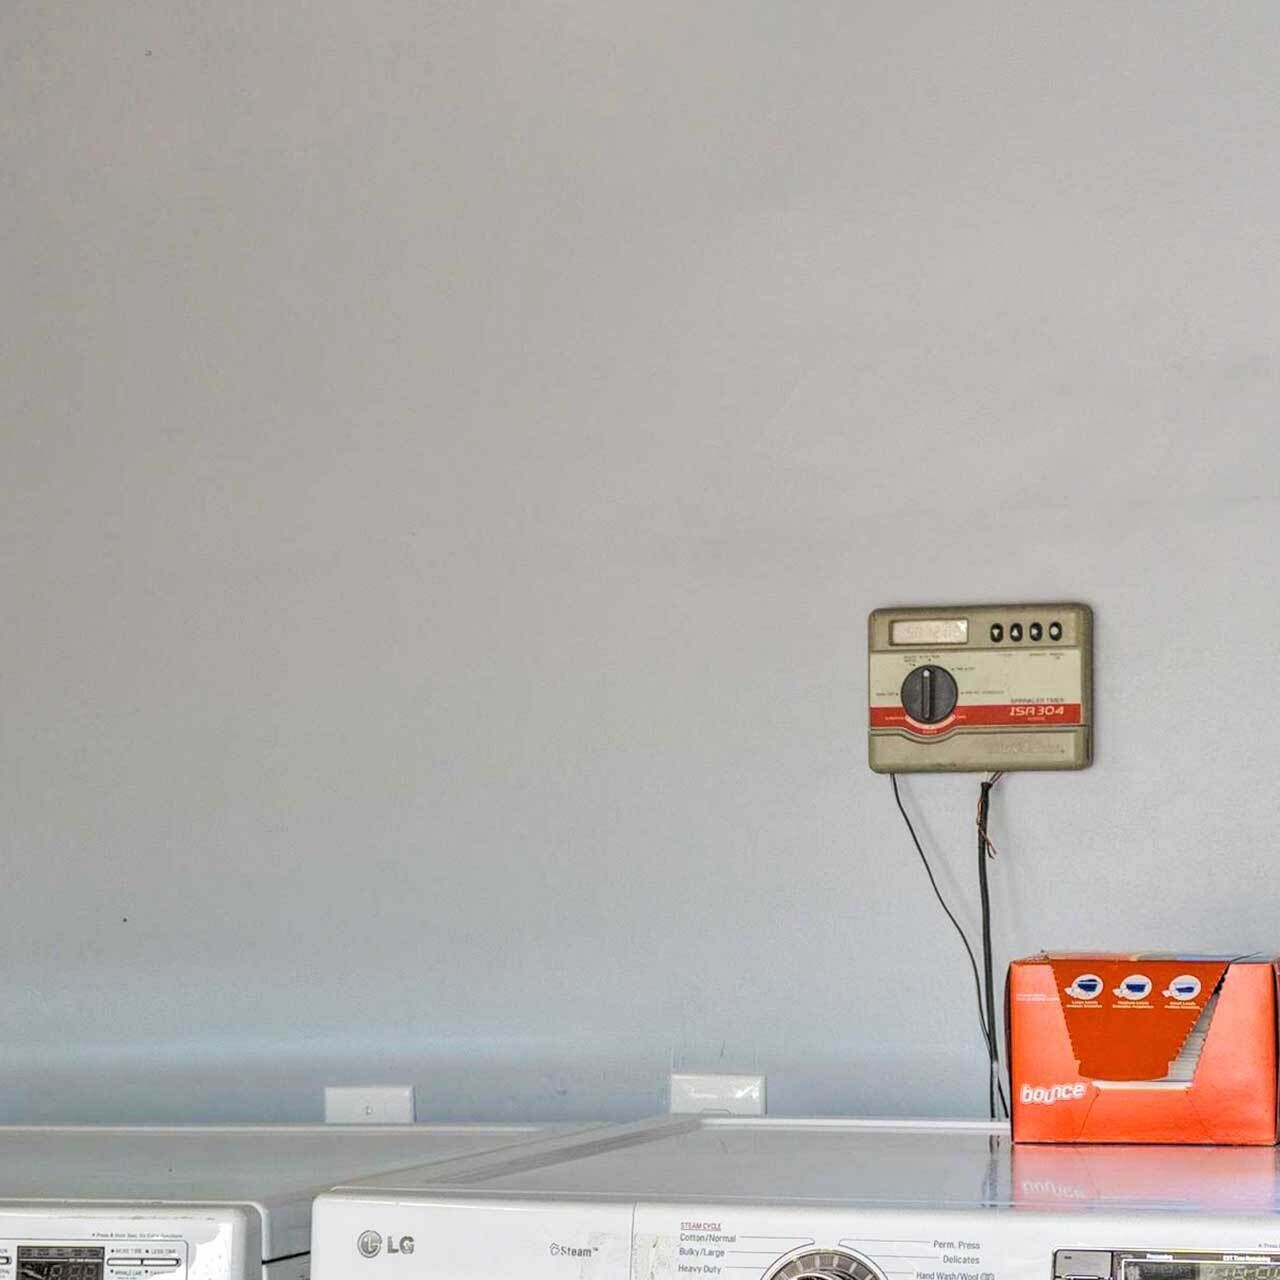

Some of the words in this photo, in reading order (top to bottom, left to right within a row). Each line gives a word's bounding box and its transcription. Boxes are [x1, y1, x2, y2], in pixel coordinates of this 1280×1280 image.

[1037, 705, 1064, 716] 304
[1021, 1082, 1086, 1105] bounce
[680, 1222, 701, 1230] STEAM
[680, 1233, 736, 1243] Cotton/Normal
[387, 1235, 415, 1255] LG
[958, 1241, 981, 1250] Press
[679, 1247, 725, 1259] Bulky/Large
[943, 1254, 980, 1264] Delicates
[678, 1264, 702, 1273] Heavy
[703, 1265, 721, 1275] Duty
[916, 1271, 935, 1280] Hand
[936, 1271, 979, 1280] Wash/Wool
